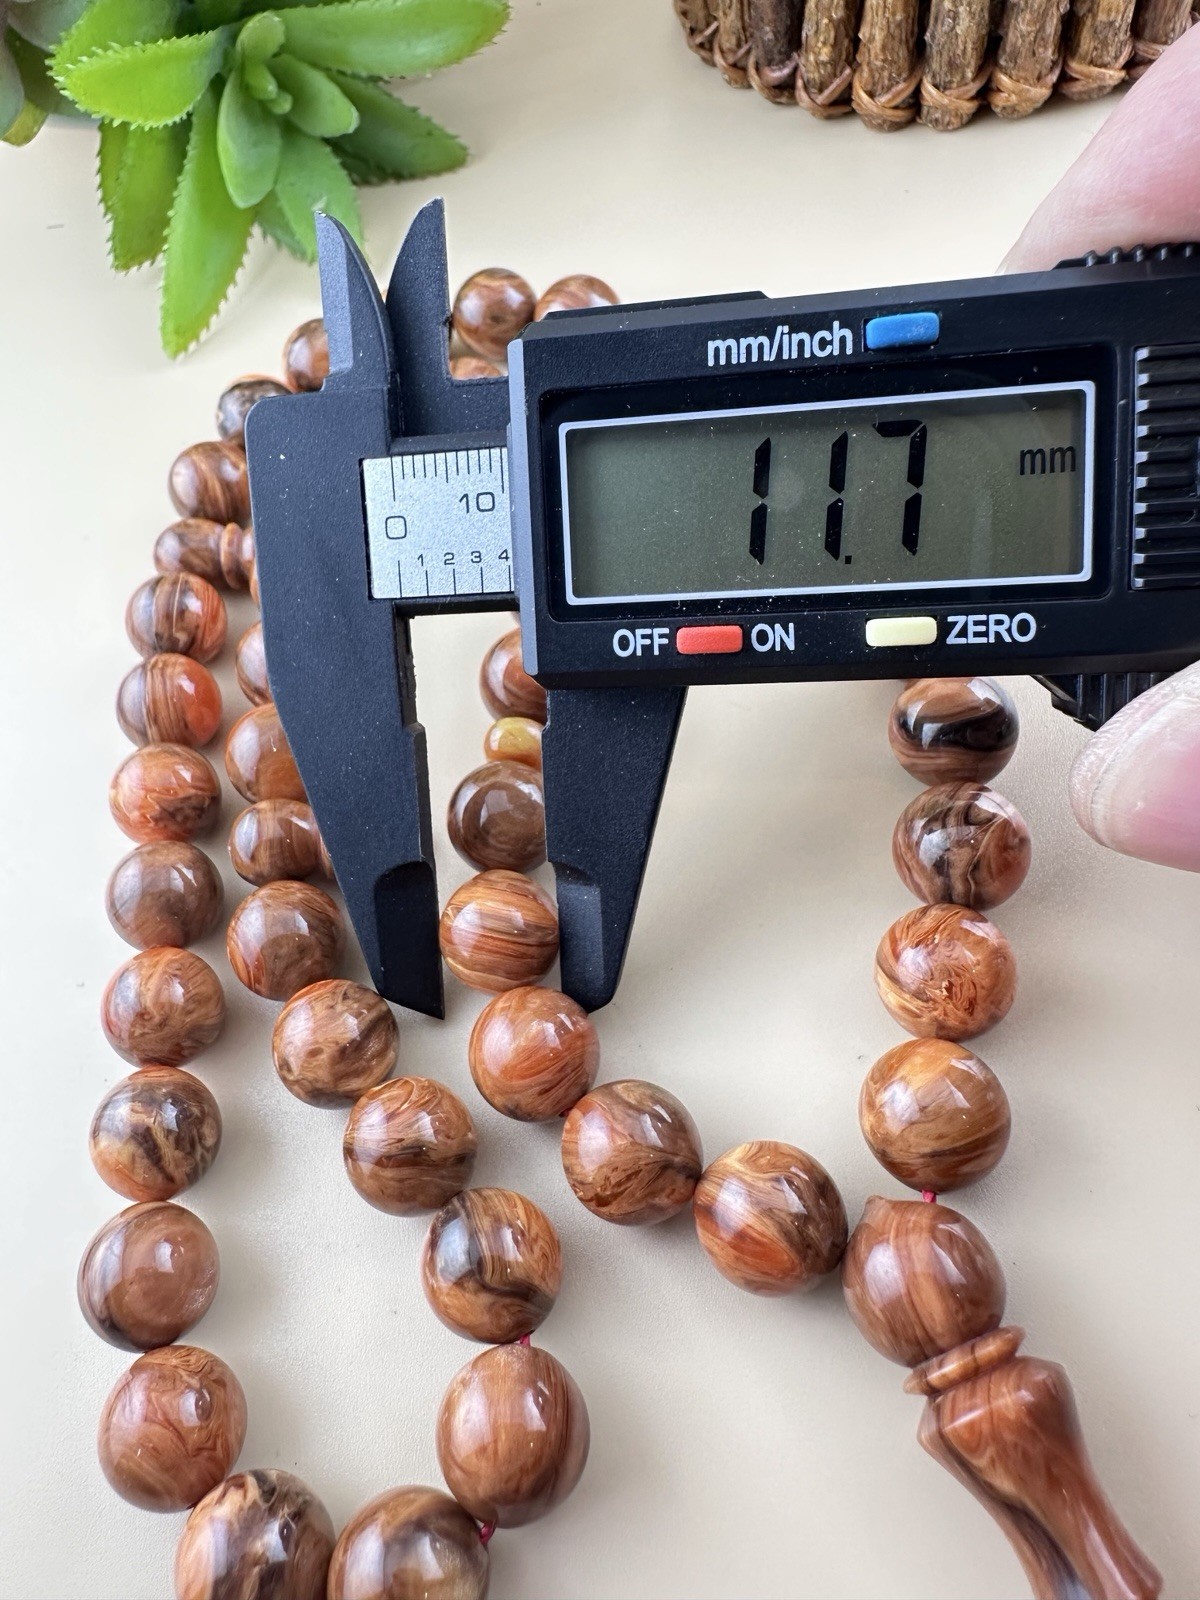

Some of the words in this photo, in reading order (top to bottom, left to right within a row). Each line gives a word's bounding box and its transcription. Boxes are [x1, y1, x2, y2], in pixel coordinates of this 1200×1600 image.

[707, 320, 853, 367] mm/inch
[459, 491, 495, 513] 10
[749, 419, 927, 565] 11.7
[1019, 443, 1077, 476] mm
[385, 515, 407, 540] 0
[417, 553, 424, 567] 1
[444, 552, 455, 565] 2
[471, 551, 482, 563] 3
[498, 549, 510, 561] 4
[612, 628, 669, 658] OFF
[751, 623, 796, 653] ON
[946, 612, 1037, 645] ZERO
